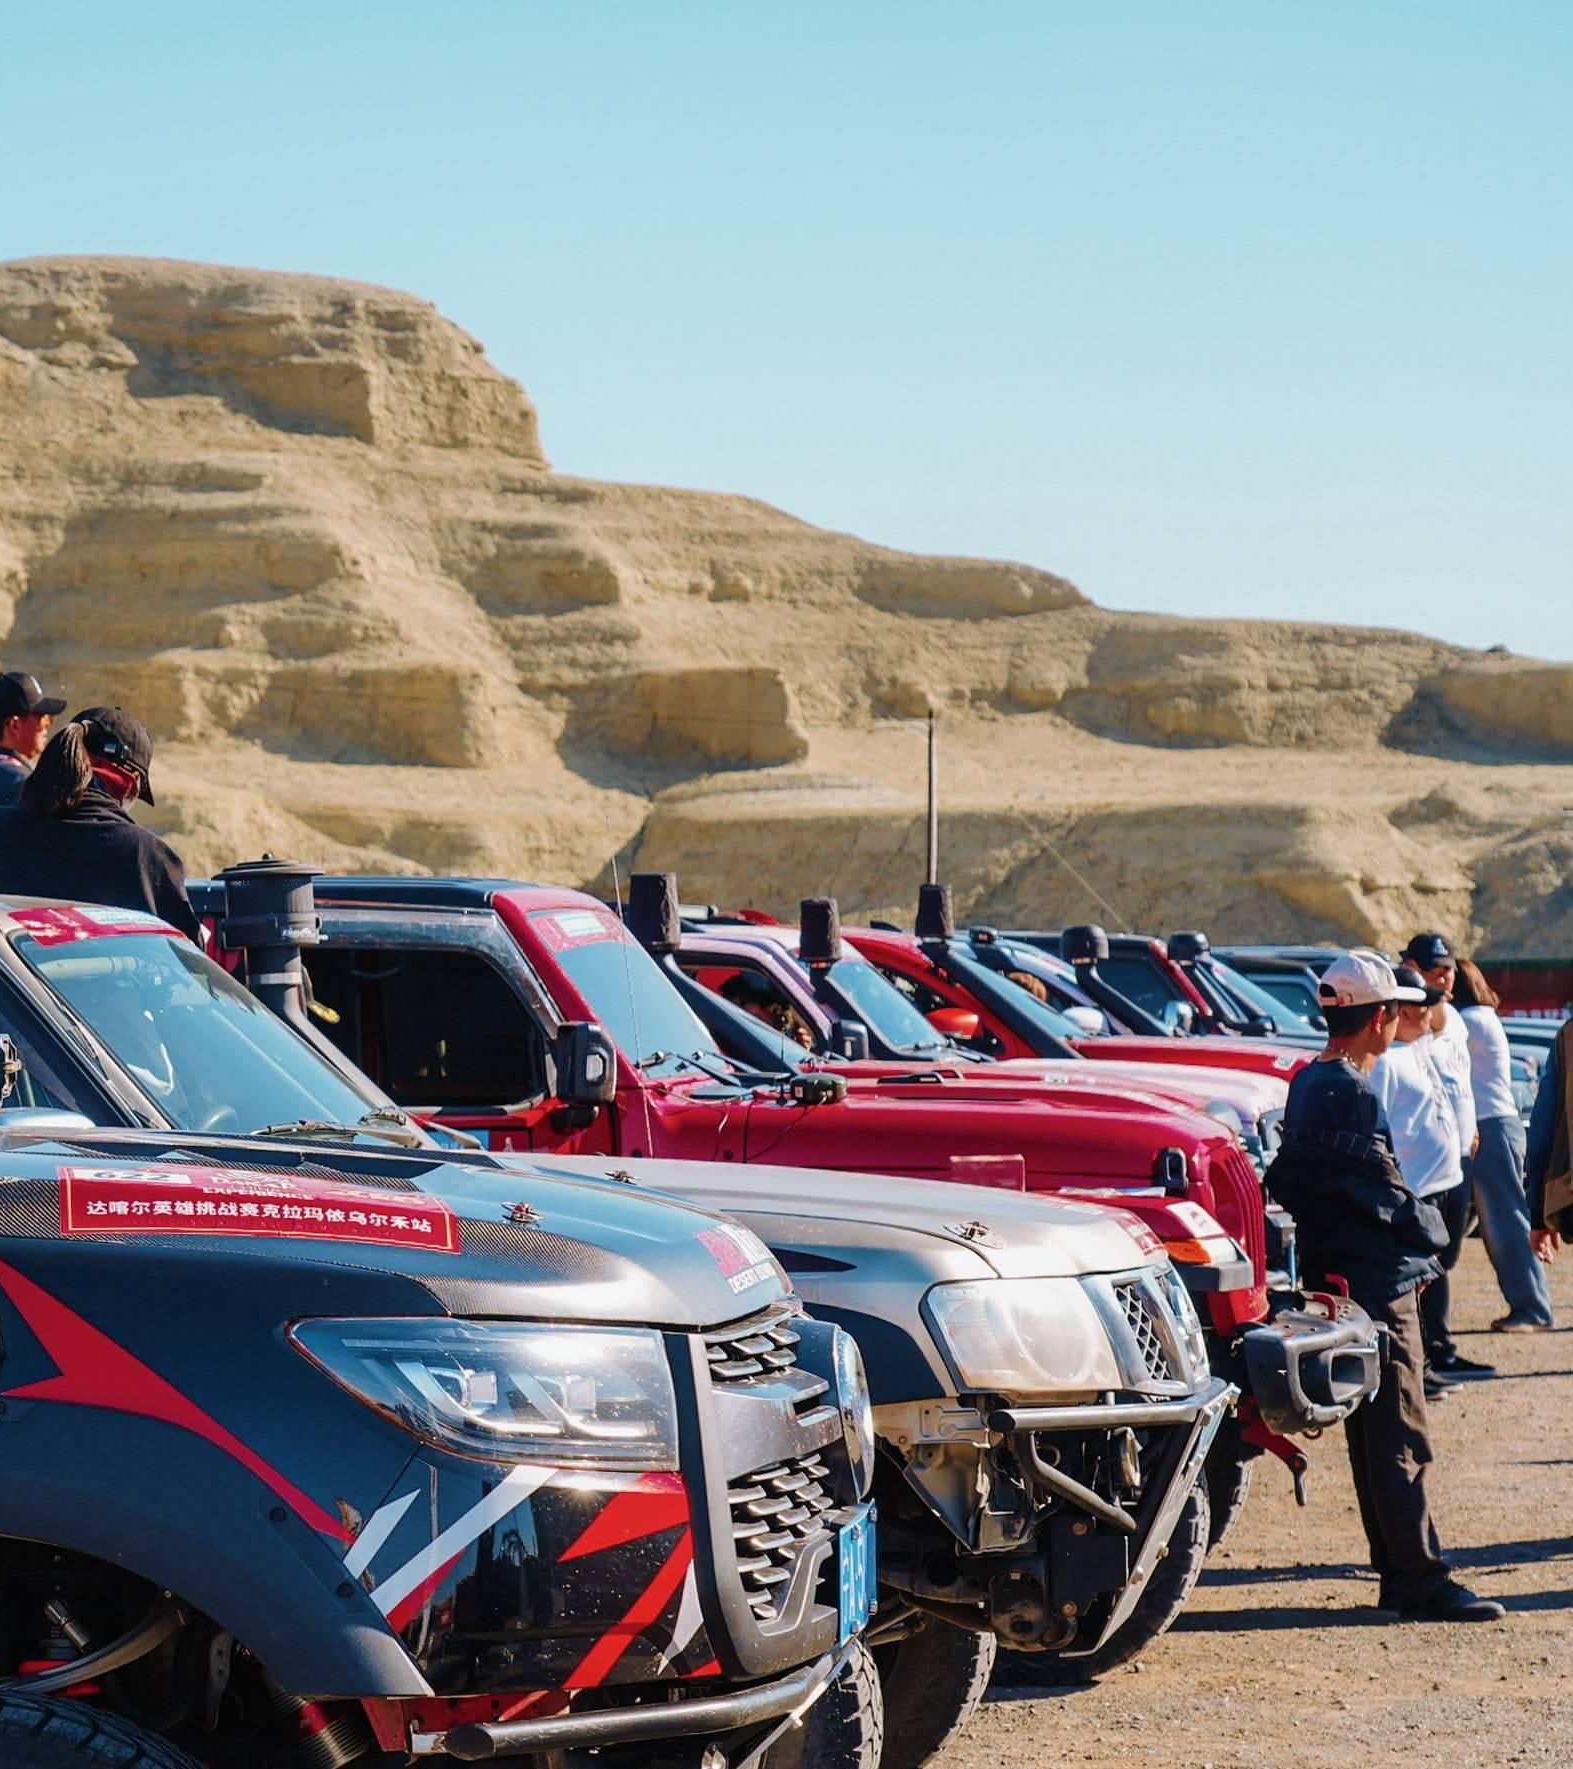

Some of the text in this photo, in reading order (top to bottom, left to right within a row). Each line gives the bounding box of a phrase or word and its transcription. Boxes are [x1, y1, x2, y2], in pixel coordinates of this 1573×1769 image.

[93, 1172, 171, 1182] 622
[86, 1200, 433, 1233] 达喀尔英雄挑战赛克拉玛依乌尔禾站
